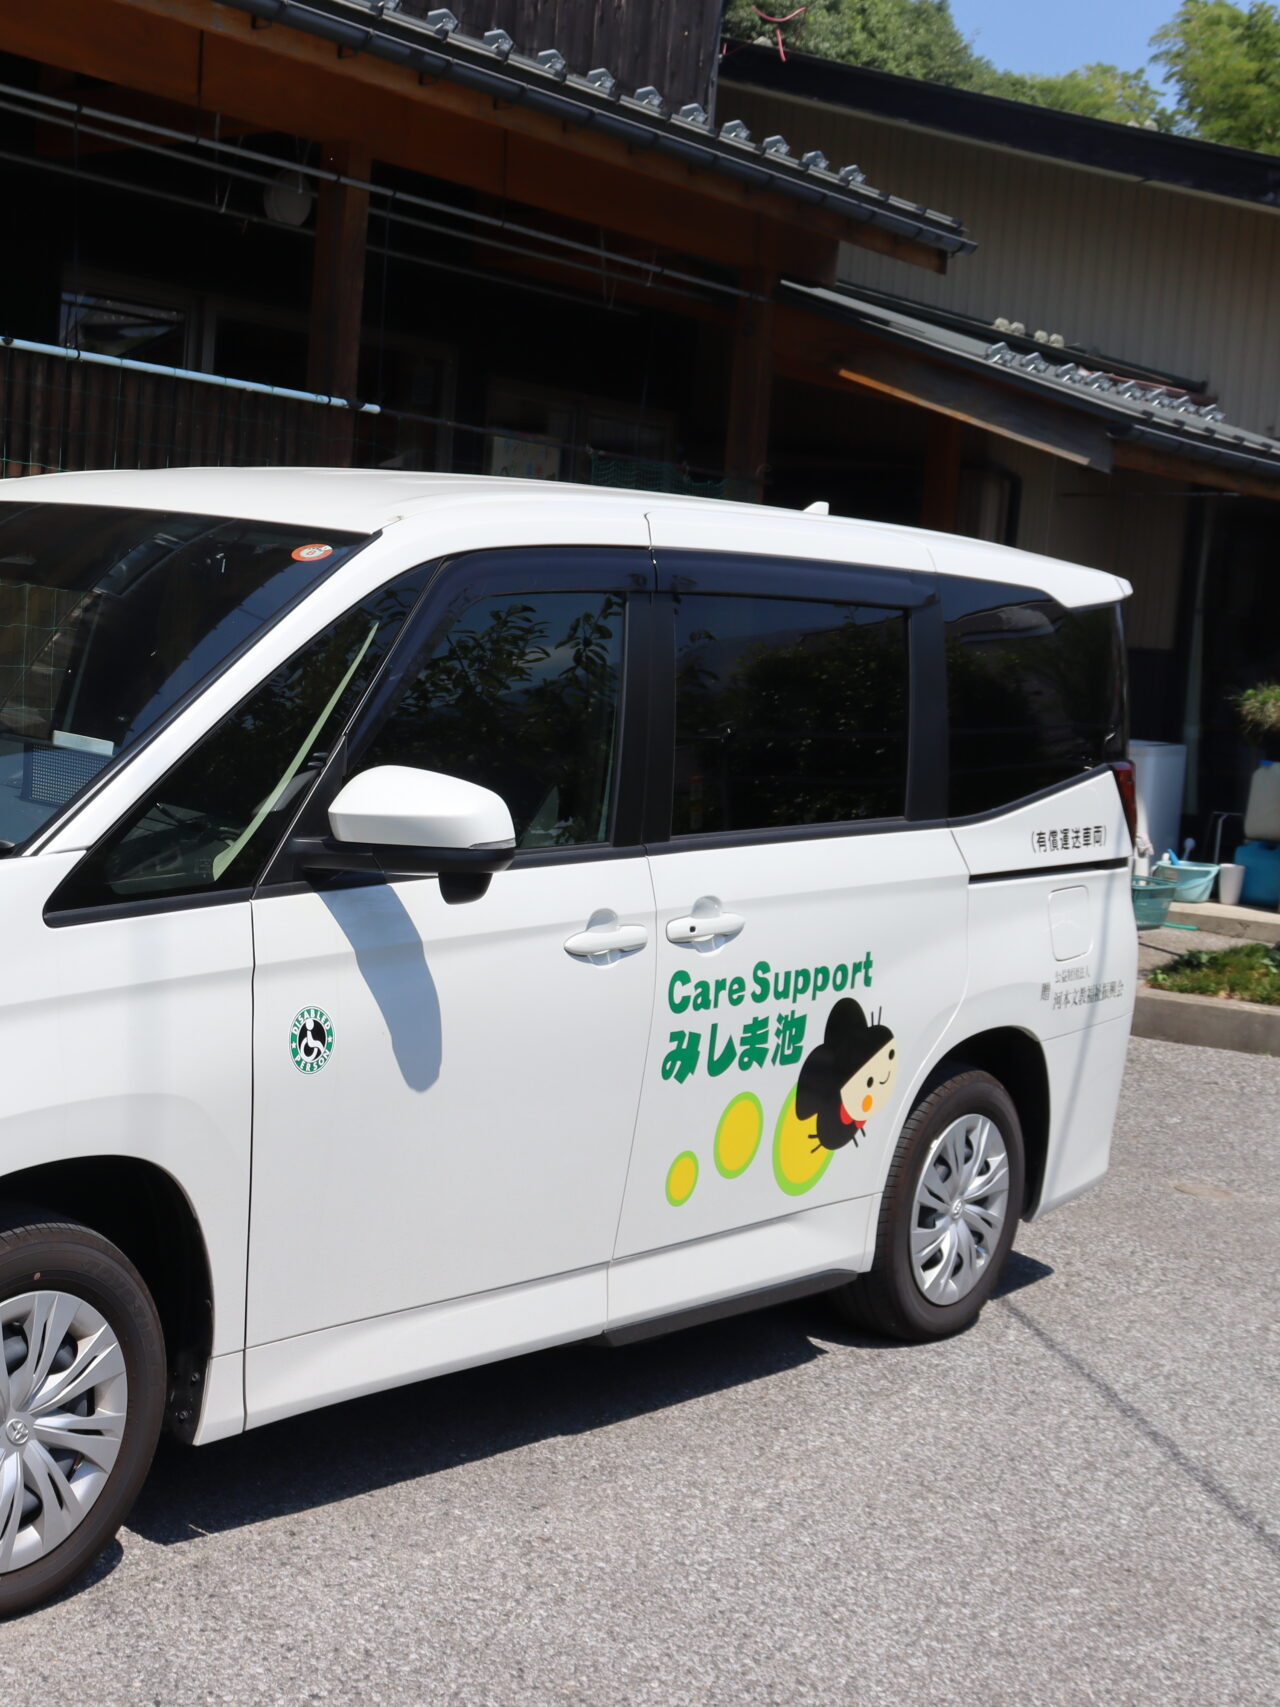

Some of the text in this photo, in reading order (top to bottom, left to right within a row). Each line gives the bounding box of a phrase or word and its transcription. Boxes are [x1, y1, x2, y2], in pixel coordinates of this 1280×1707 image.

[292, 1008, 331, 1035] DISABLED
[661, 1010, 807, 1084] みしま池
[295, 1050, 330, 1072] PERSON
